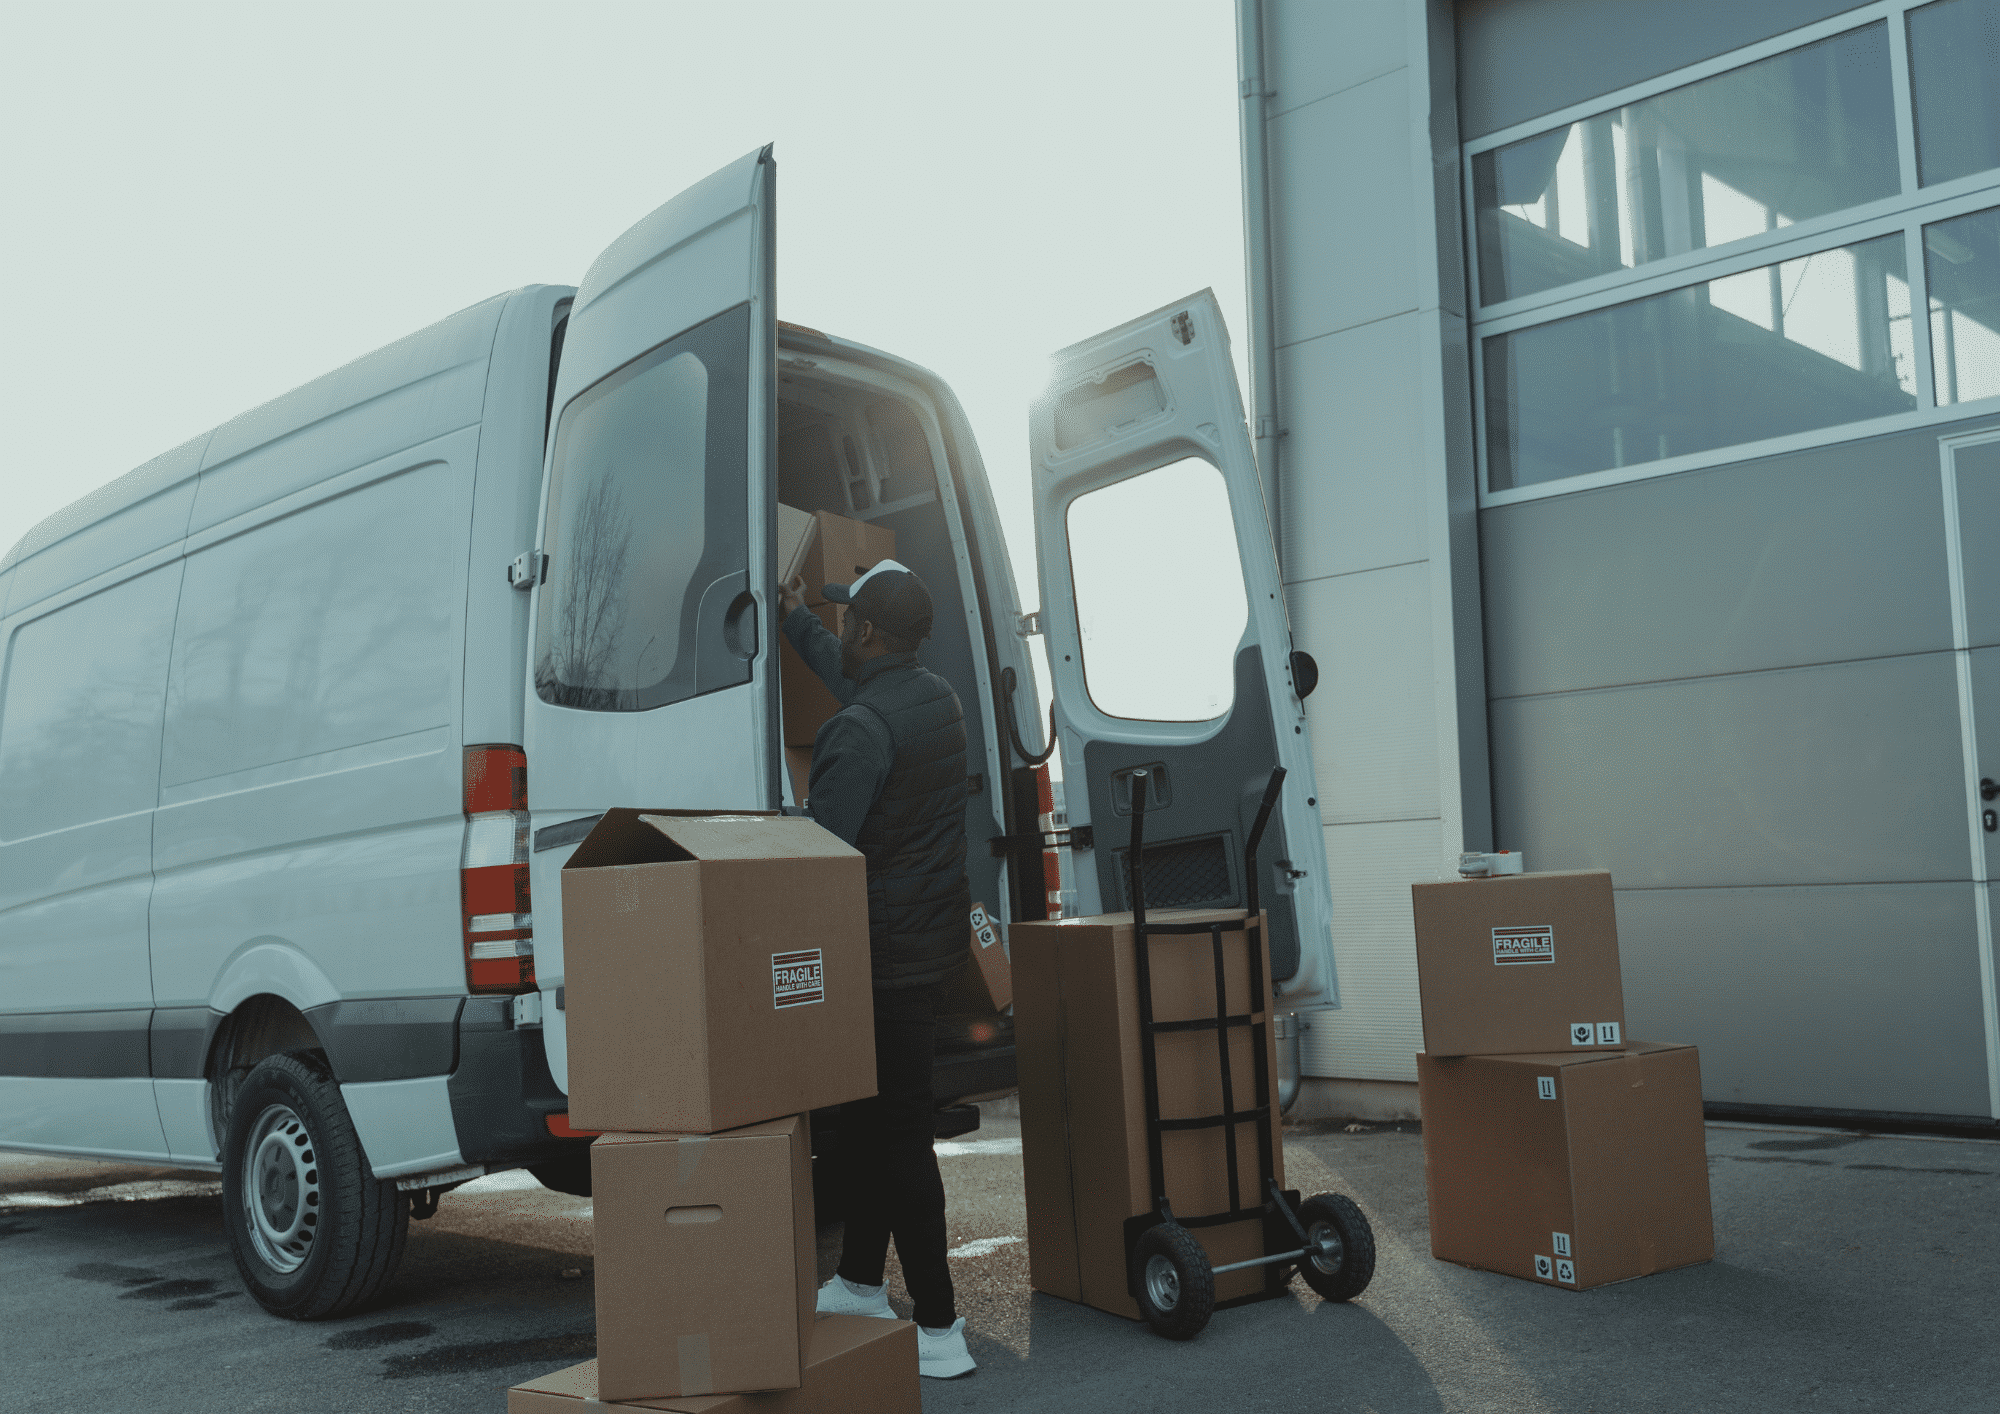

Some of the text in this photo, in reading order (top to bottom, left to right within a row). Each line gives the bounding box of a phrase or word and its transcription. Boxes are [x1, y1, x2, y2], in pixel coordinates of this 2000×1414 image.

[1496, 937, 1550, 949] FRAGILE
[775, 965, 821, 985] FRAGILE
[776, 983, 795, 992] HANDLE
